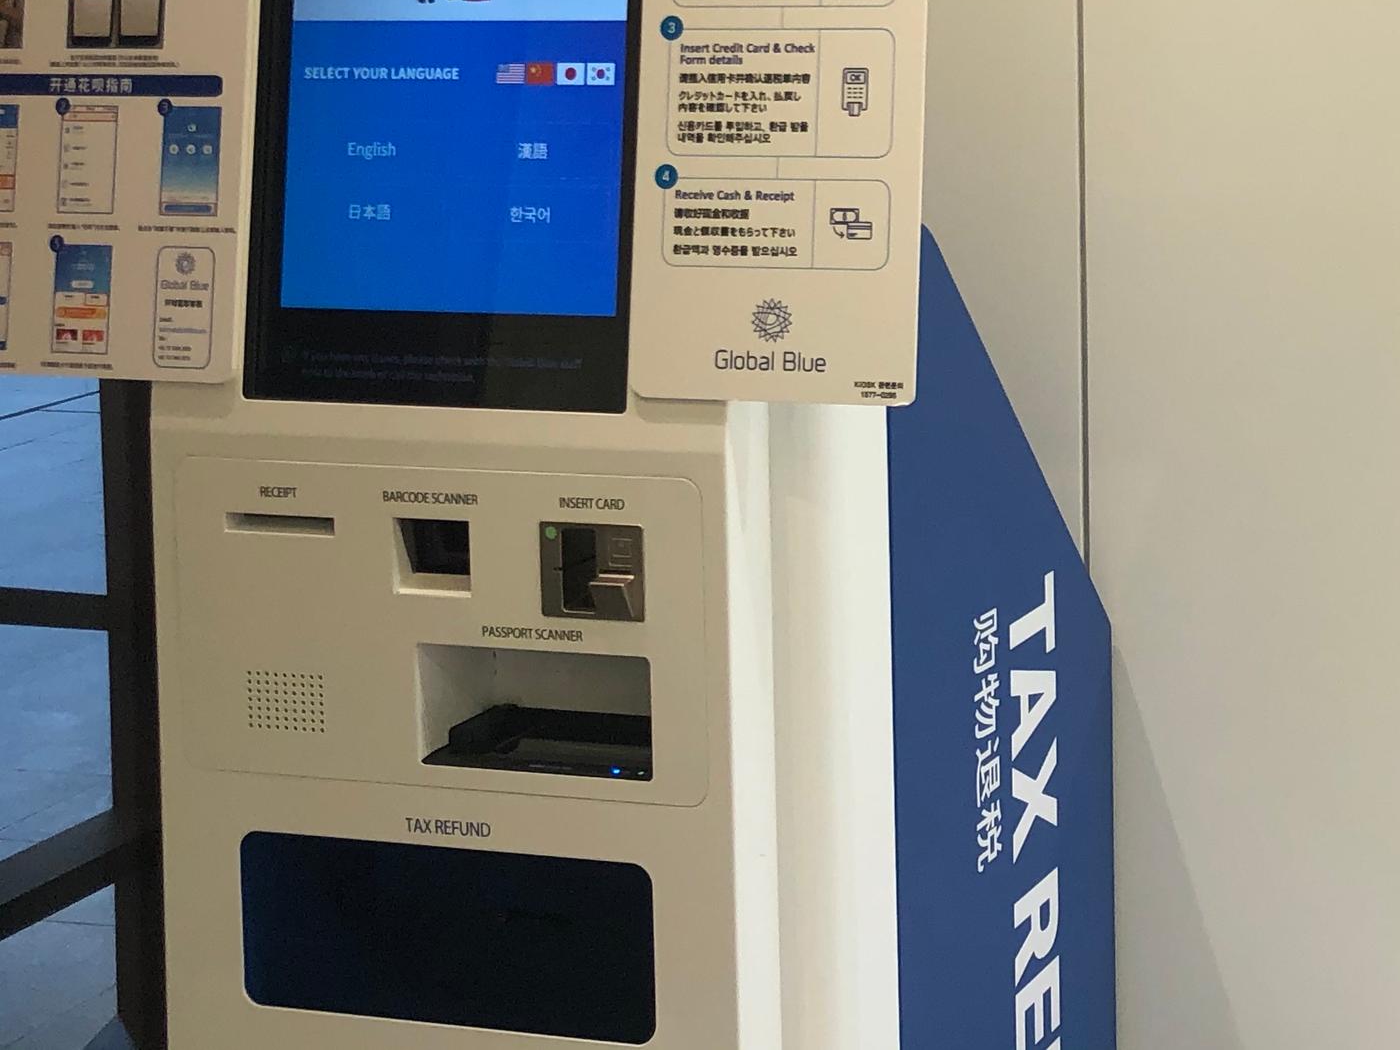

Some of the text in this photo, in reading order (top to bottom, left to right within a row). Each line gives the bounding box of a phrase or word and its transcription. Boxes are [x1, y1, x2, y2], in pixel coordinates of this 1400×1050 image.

[680, 43, 815, 54] Insert Credit Card & Check
[680, 54, 743, 65] Form details
[303, 67, 460, 81] SELECT YOUR LANGUAGE
[347, 141, 397, 160] English
[674, 190, 795, 202] Receive Cash & Receipt
[348, 204, 391, 221] 日本語
[509, 206, 551, 224] 한국어
[714, 349, 827, 373] Global Blue
[259, 486, 298, 499] RECEIPT
[382, 490, 479, 506] BARCODE SCANNER
[558, 496, 626, 511] INSERT CARD
[481, 625, 584, 643] PASSPORT SCANNER
[973, 606, 1003, 874] 购物退税
[1008, 569, 1061, 1050] TAX RE
[405, 816, 491, 838] TAX REFUND
